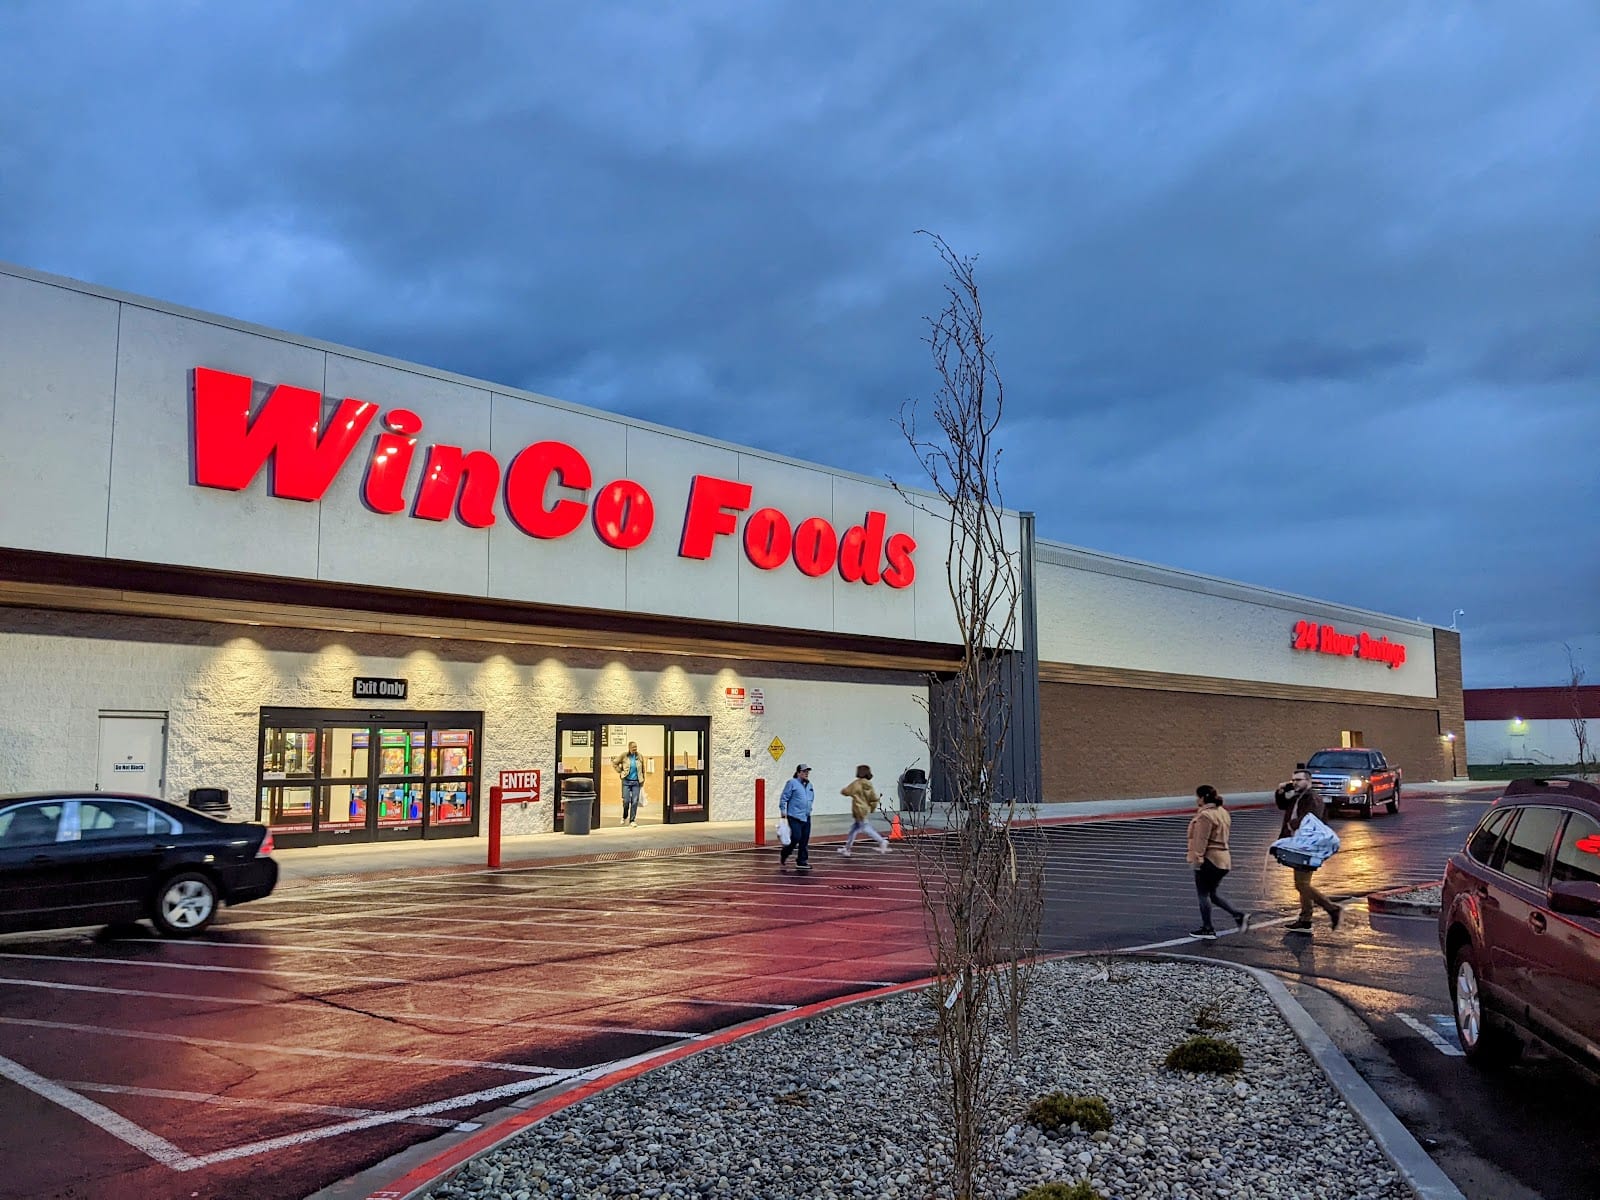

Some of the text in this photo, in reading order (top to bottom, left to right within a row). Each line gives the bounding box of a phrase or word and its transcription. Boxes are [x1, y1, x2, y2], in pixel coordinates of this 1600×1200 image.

[191, 367, 917, 589] WinCo Foods
[1294, 619, 1407, 669] 24 Hour Savings
[356, 680, 405, 697] Exit Only
[502, 772, 538, 789] ENTER
